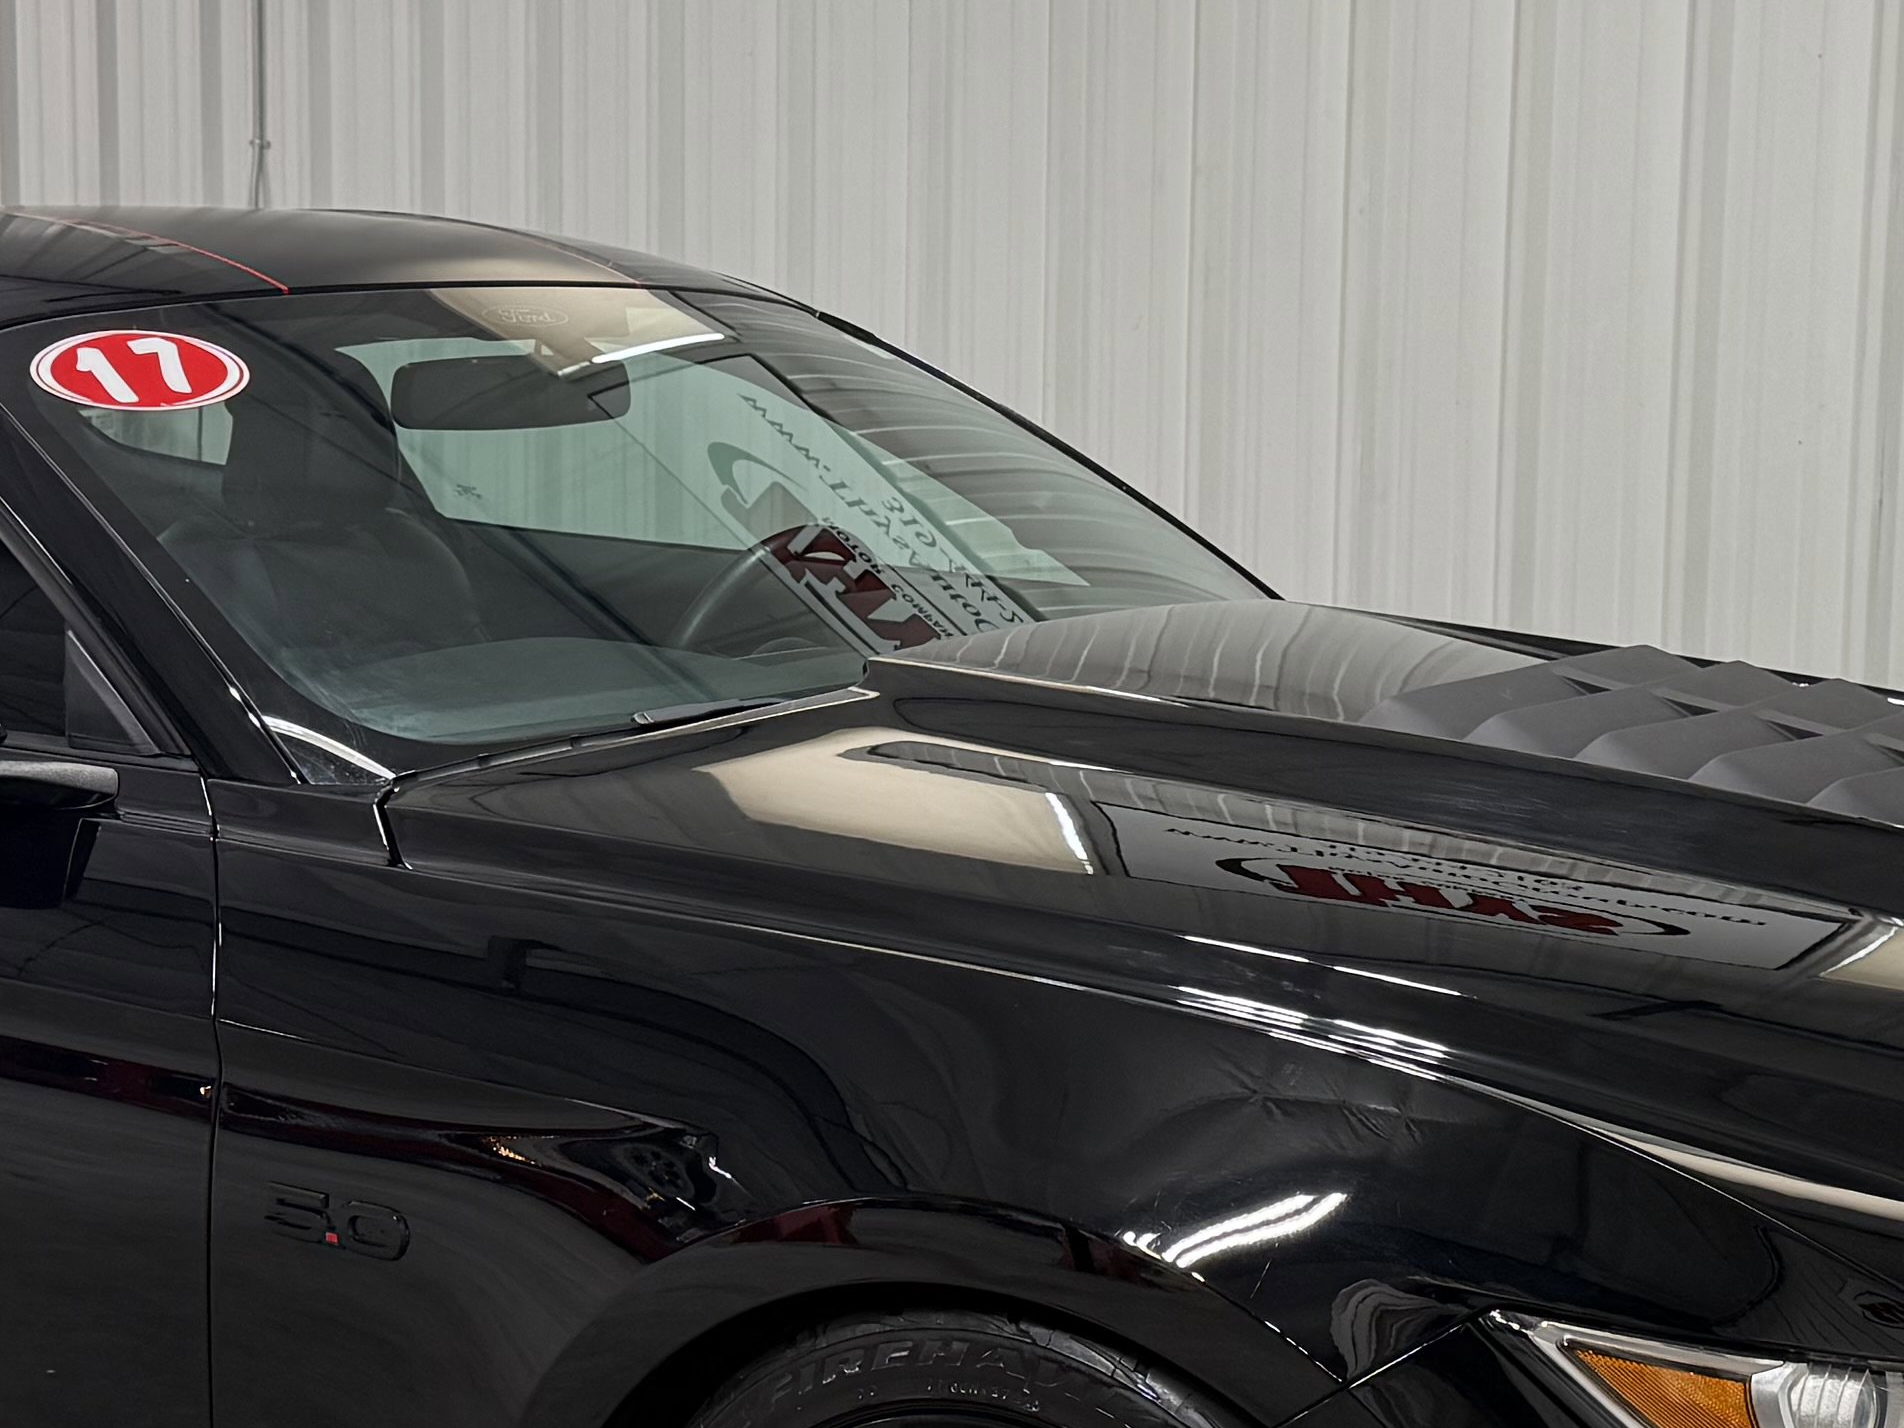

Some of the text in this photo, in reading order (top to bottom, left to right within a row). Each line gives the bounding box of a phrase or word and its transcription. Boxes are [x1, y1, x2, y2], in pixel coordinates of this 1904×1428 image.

[498, 308, 557, 323] Ford
[76, 337, 192, 403] 17
[264, 1180, 411, 1262] 5.0
